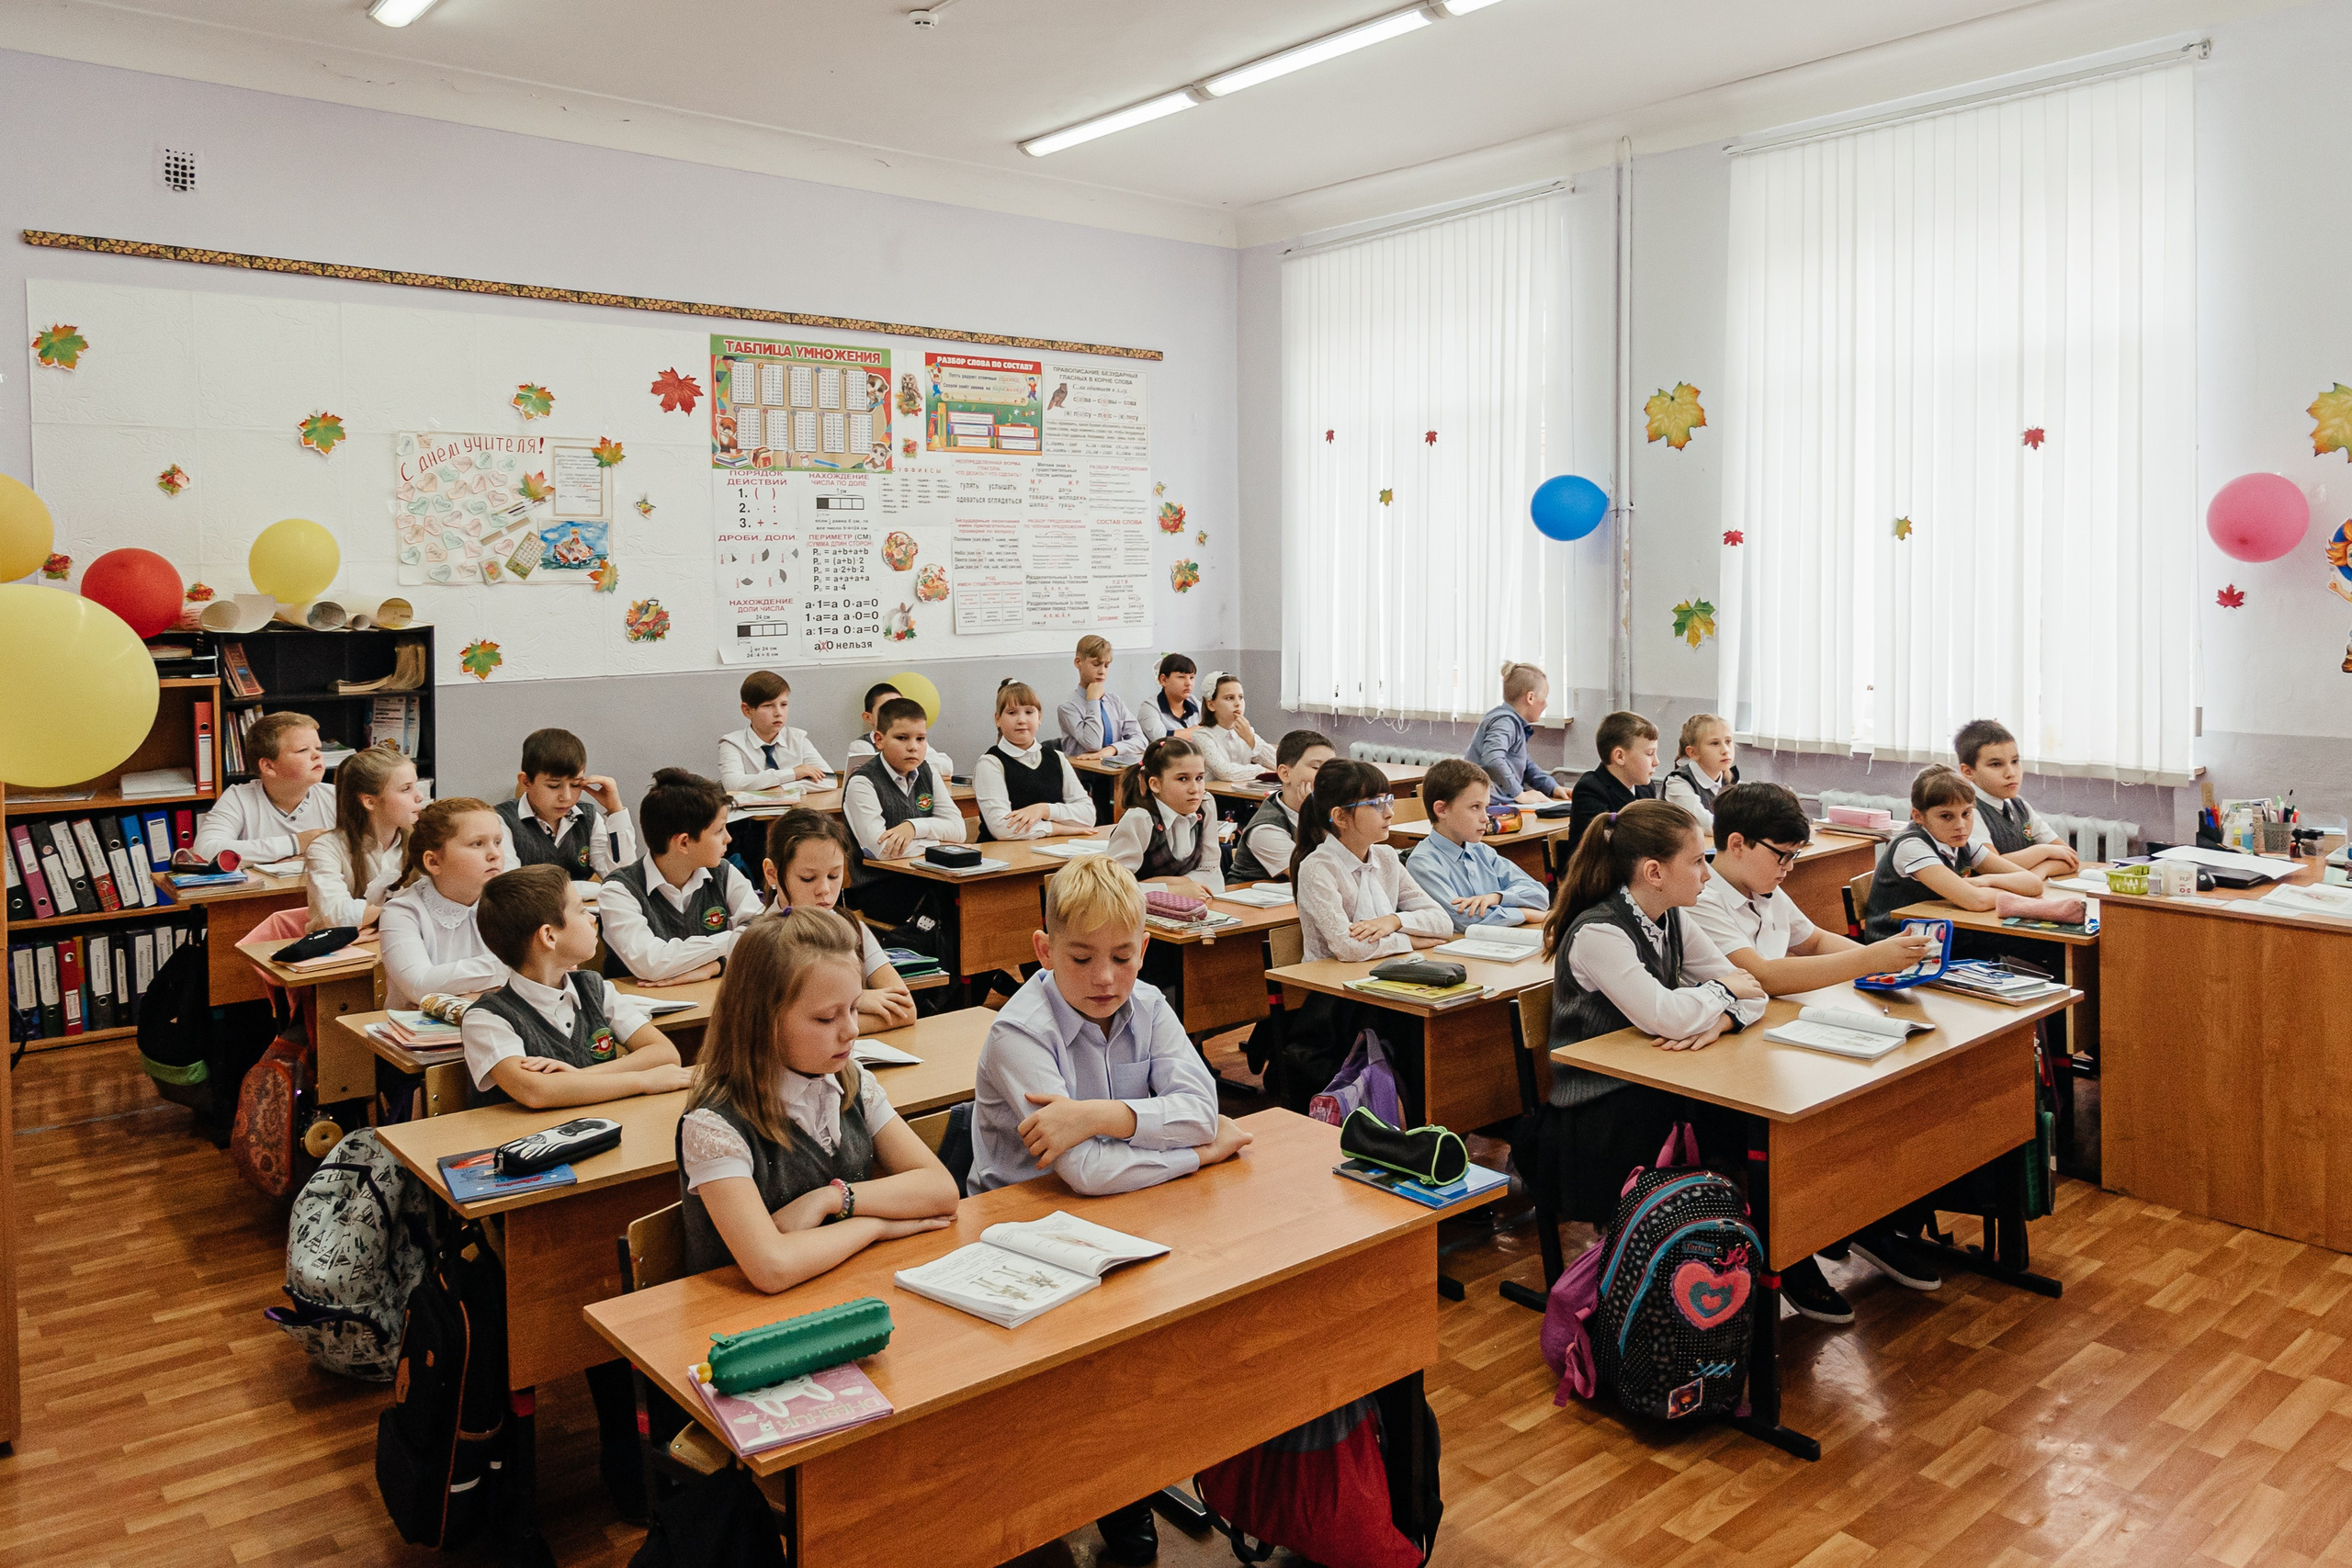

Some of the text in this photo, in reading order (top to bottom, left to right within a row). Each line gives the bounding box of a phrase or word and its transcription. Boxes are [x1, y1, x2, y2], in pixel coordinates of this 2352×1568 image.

[725, 340, 881, 364] ТАБЛИЦА УМНОЖЕНИЯ
[937, 356, 966, 365] РАЗБОР
[967, 359, 990, 367] СЛОВА
[1003, 362, 1034, 370] СОСТАВУ
[1053, 367, 1100, 375] ПРАВОПИСАНИЕ
[401, 463, 413, 481] С
[727, 478, 787, 486] ДЕЙСТВИЙ
[738, 489, 748, 498] 1.
[739, 503, 751, 513] 2.
[740, 518, 752, 528] 3.
[729, 598, 794, 606] НАХОЖДЕНИЕ
[836, 641, 873, 650] нельзя
